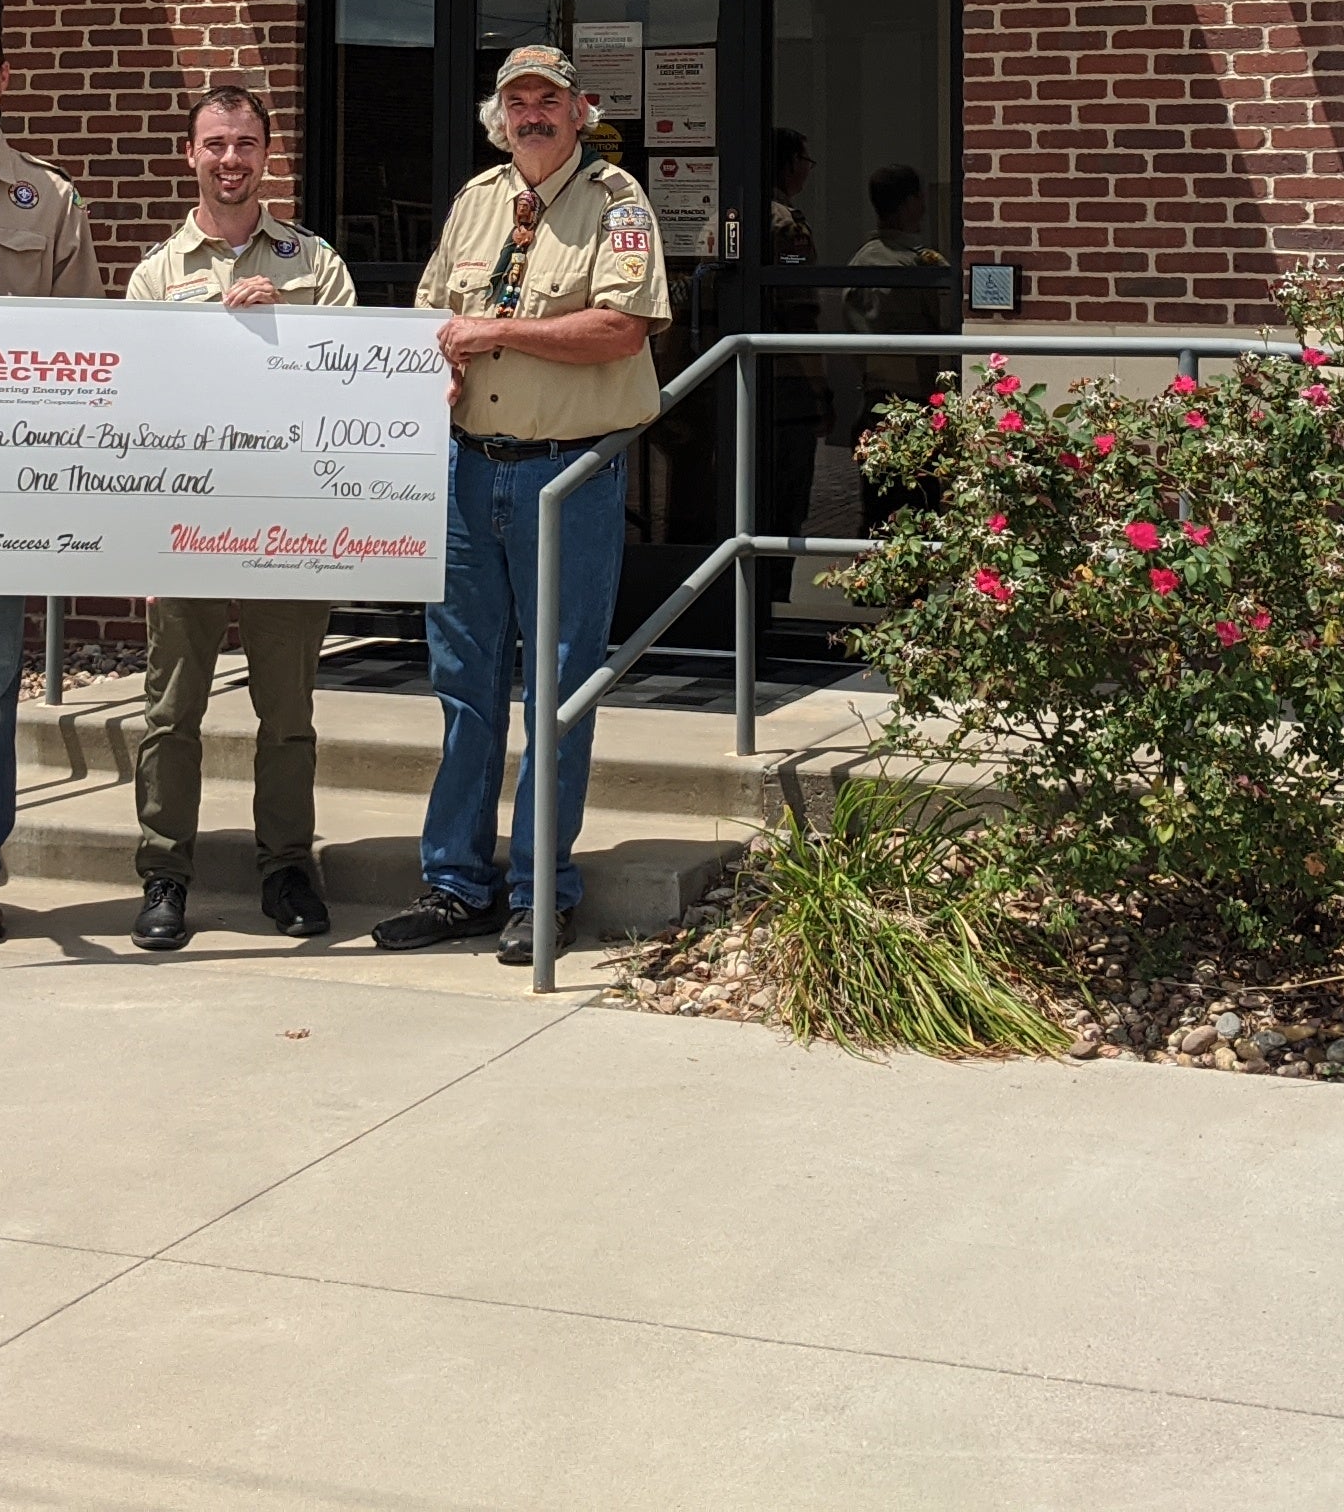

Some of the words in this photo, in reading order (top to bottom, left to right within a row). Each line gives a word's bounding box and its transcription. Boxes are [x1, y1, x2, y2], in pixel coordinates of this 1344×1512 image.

[613, 231, 647, 250] 853
[267, 355, 303, 371] Date:
[306, 339, 359, 386] July
[32, 386, 75, 396] Energy
[77, 387, 93, 395] for
[96, 387, 118, 396] Life
[44, 398, 87, 406] Cooperative
[133, 422, 187, 450] Scouts
[193, 424, 215, 451] of
[219, 424, 289, 451] America
[17, 466, 59, 492] One
[61, 464, 168, 494] Thousand
[171, 467, 216, 495] and
[368, 479, 437, 502] Dollars
[56, 533, 104, 554] Fund
[170, 523, 261, 554] Wheatland
[264, 525, 327, 556] Electric
[332, 526, 428, 563] Cooperative
[241, 558, 302, 570] Authorized
[303, 558, 356, 574] Signature
